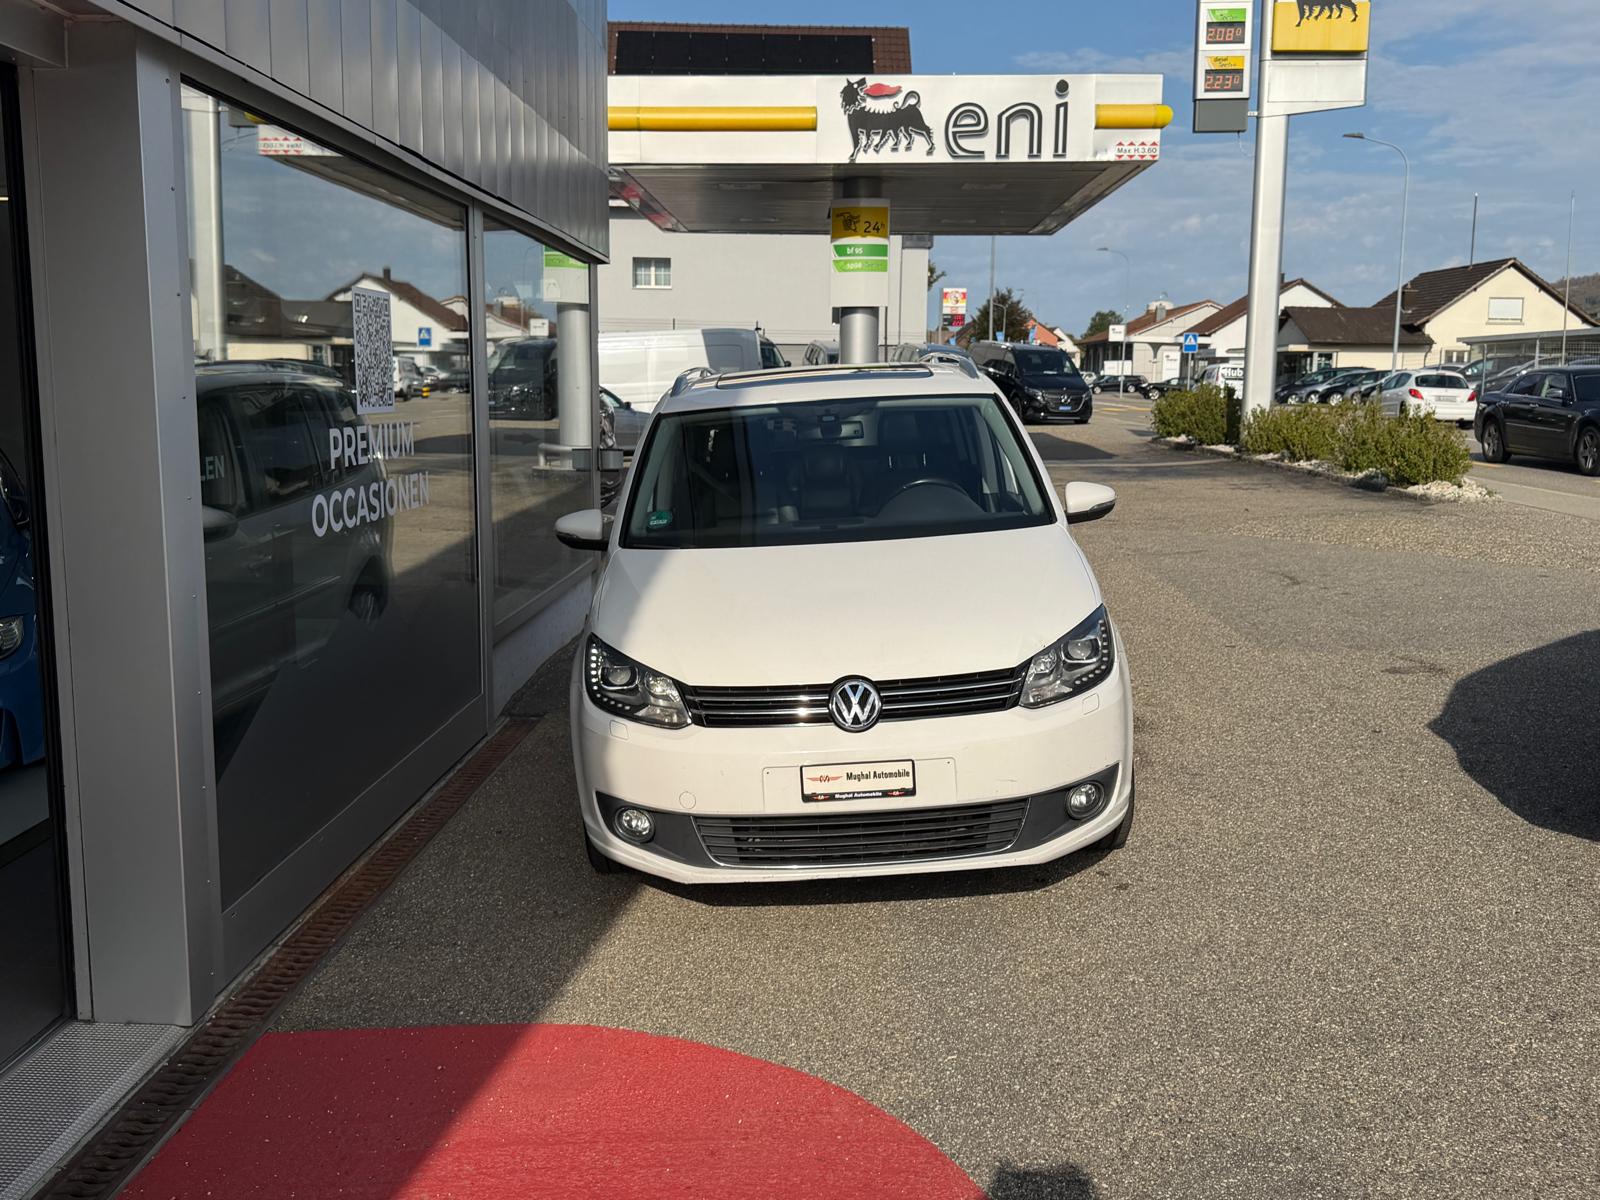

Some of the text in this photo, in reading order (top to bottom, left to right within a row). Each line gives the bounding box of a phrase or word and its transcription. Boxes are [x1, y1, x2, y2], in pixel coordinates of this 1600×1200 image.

[945, 79, 1070, 159] eni
[329, 420, 415, 470] PREMIUM
[312, 471, 430, 538] OCCASIONEN
[846, 769, 910, 782] Mughal Automobile
